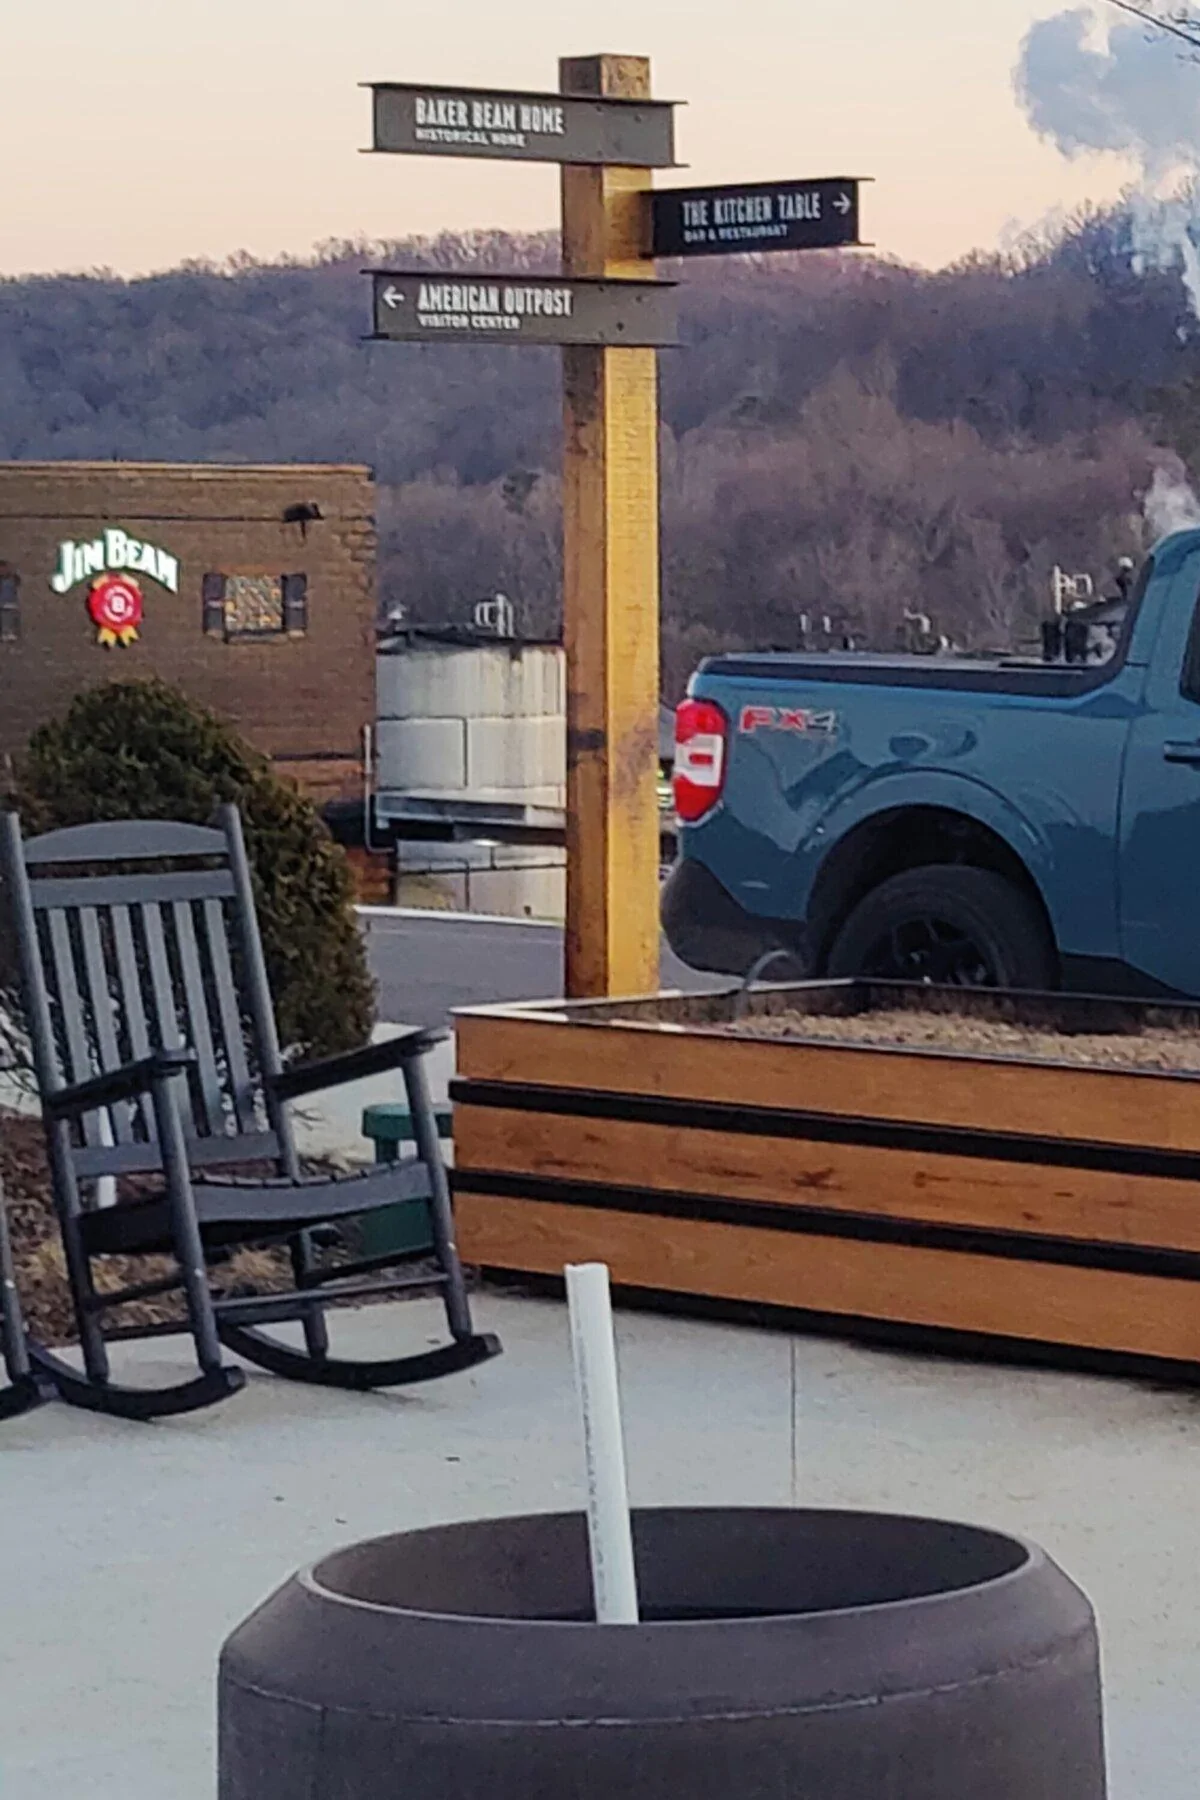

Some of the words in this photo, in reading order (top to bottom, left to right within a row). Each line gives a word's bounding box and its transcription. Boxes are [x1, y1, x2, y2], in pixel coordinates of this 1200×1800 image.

[415, 97, 469, 128] BAKER
[472, 101, 516, 131] BEAM
[521, 104, 564, 134] HOME
[682, 200, 708, 226] THE
[714, 197, 772, 224] KITCHEN
[777, 192, 821, 220] TABLE
[417, 283, 500, 313] AMERICAN
[504, 287, 572, 315] OUTPOST
[417, 313, 469, 328] VISITOR
[470, 314, 521, 330] CENTER
[740, 705, 837, 734] FX4
